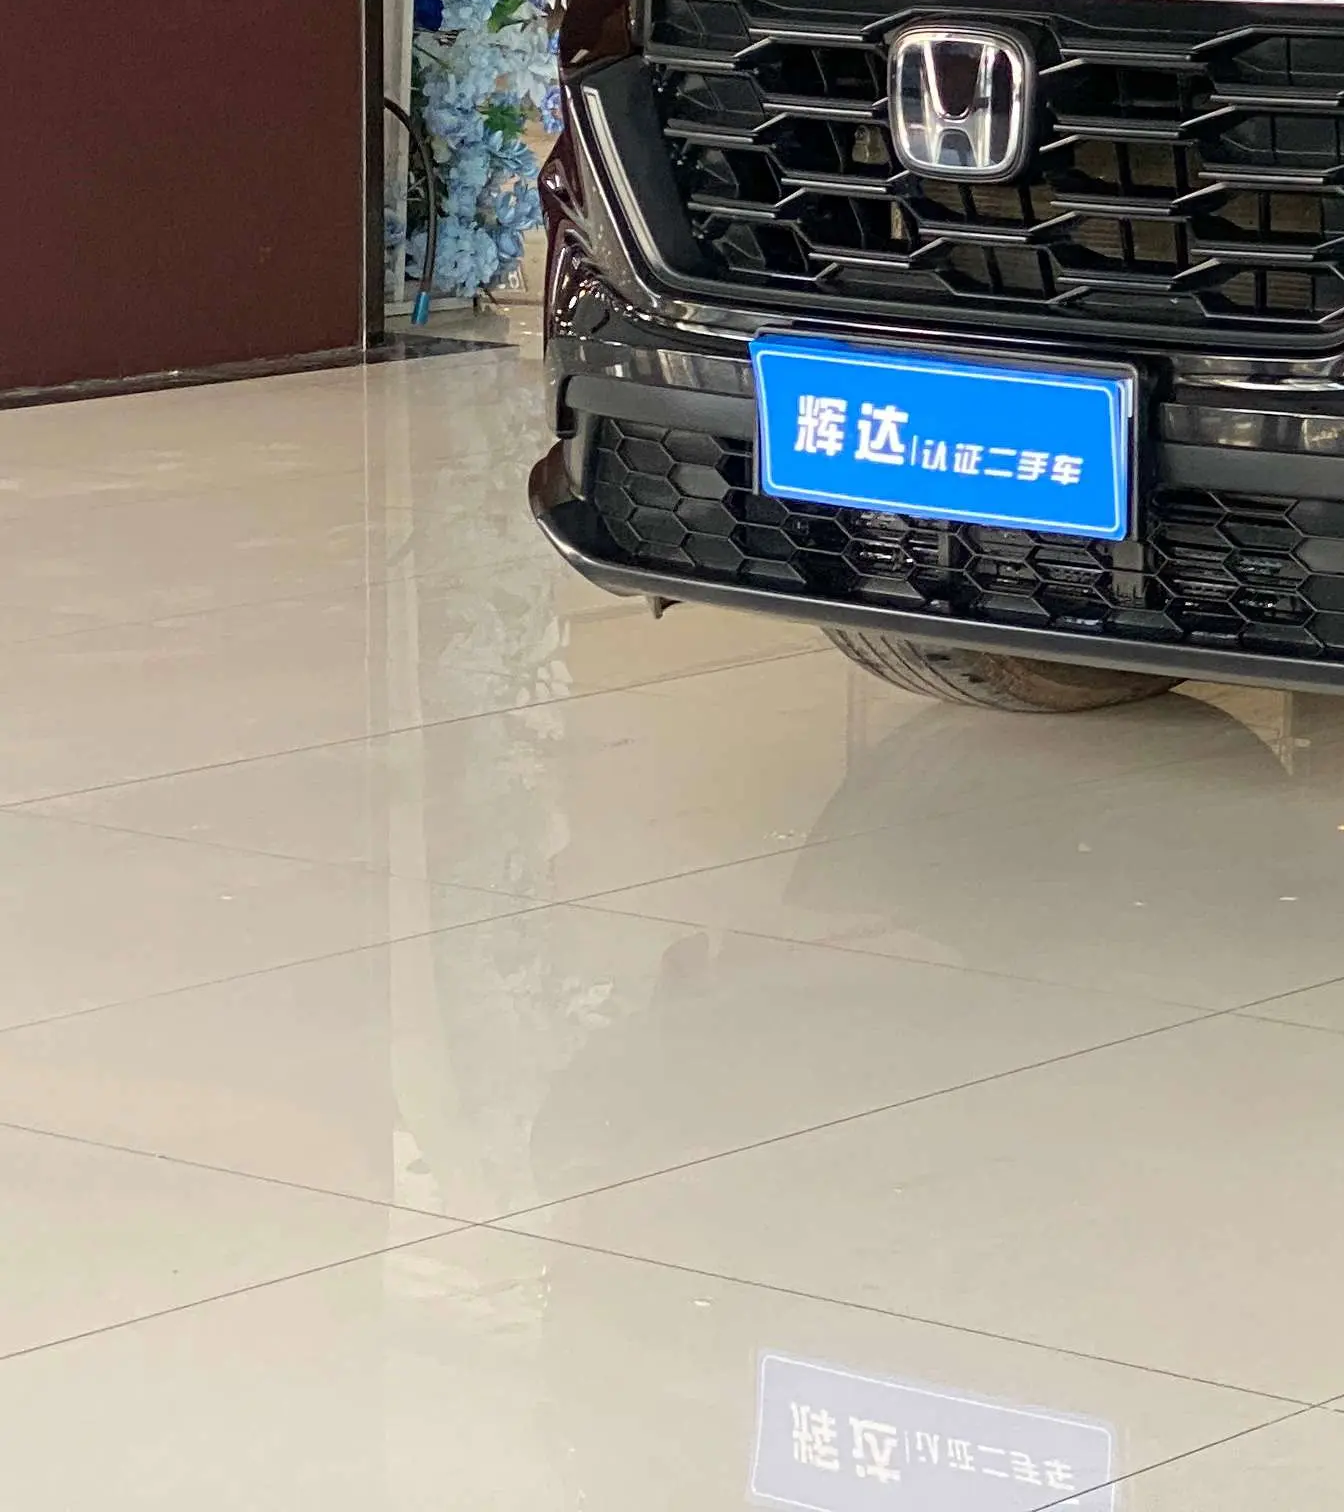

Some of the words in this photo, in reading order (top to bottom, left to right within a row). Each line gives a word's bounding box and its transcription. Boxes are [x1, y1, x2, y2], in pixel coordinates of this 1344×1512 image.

[794, 394, 909, 466] 辉达
[921, 439, 1085, 485] 认证二手车
